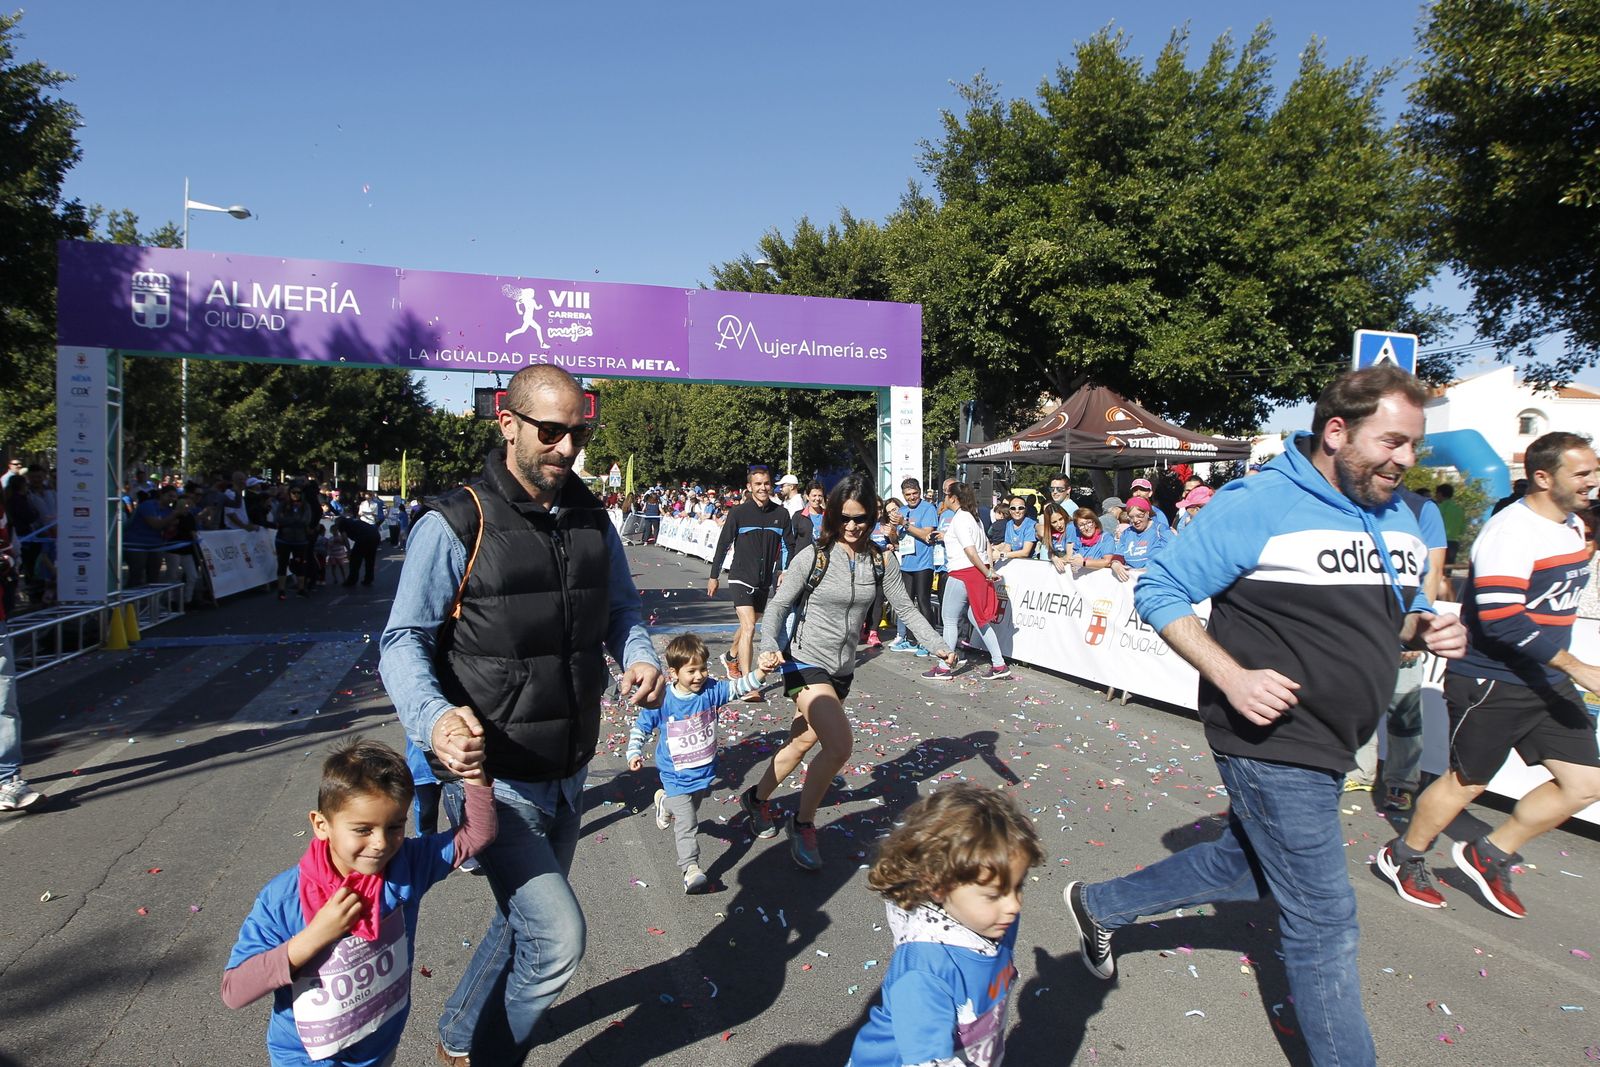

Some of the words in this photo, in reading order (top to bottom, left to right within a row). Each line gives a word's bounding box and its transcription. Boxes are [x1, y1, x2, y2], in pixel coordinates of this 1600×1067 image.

[205, 280, 361, 316] ALMERÍA
[548, 289, 590, 309] VIII
[204, 310, 286, 331] CIUDAD
[548, 310, 592, 320] CARRERA
[547, 322, 593, 343] mujer
[408, 348, 430, 361] LA
[436, 348, 524, 366] IGUALDAD
[528, 353, 548, 366] ES
[554, 354, 627, 370] NUESTRA
[631, 358, 681, 373] META.
[1019, 589, 1085, 619] ALMERÍA
[1015, 612, 1046, 630] CIUDAD
[1119, 632, 1170, 656] CIUDAD
[678, 725, 714, 749] 3036
[310, 950, 394, 1006] 3090
[341, 989, 371, 1010] DARIO
